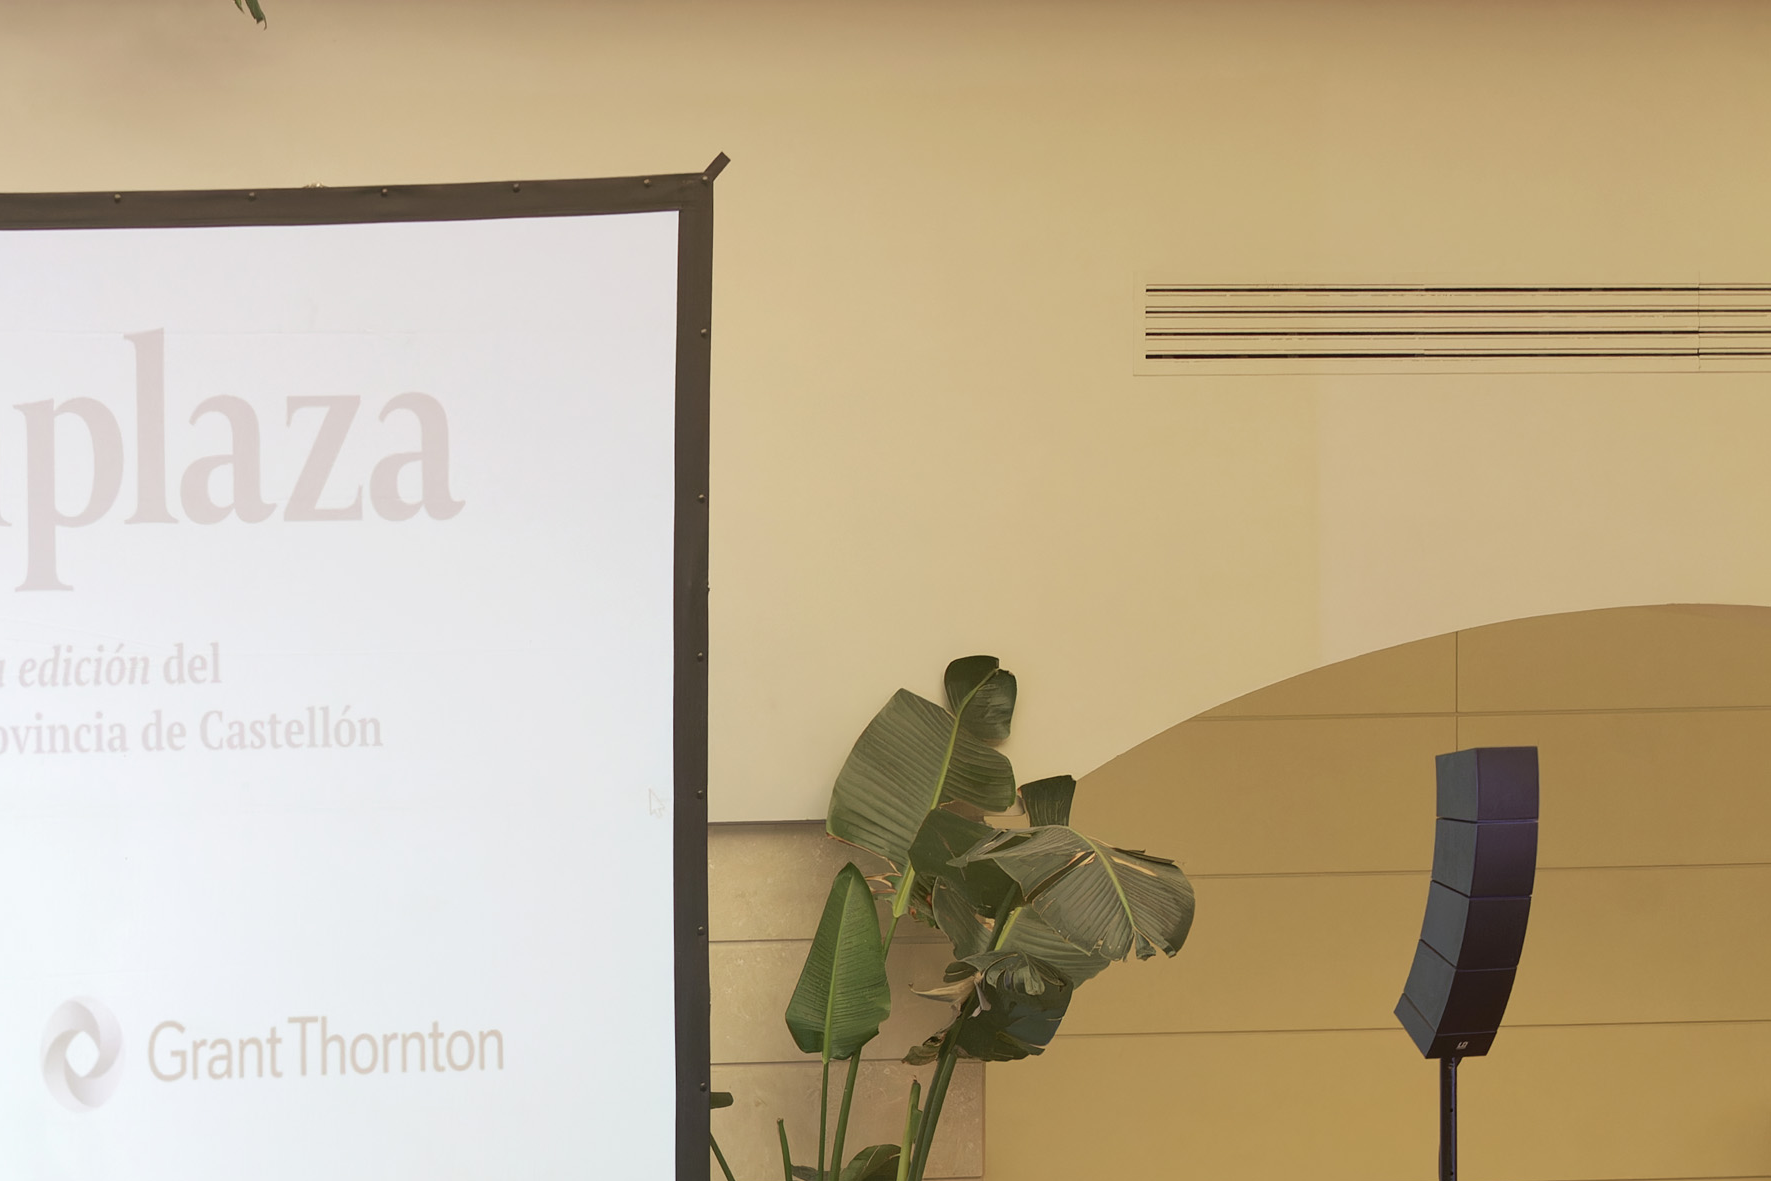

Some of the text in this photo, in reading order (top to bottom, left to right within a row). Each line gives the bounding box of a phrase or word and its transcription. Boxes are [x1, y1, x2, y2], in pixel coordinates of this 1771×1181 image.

[18, 642, 151, 688] edición
[162, 641, 223, 685] del
[140, 709, 188, 752] de
[198, 705, 384, 751] Castellón
